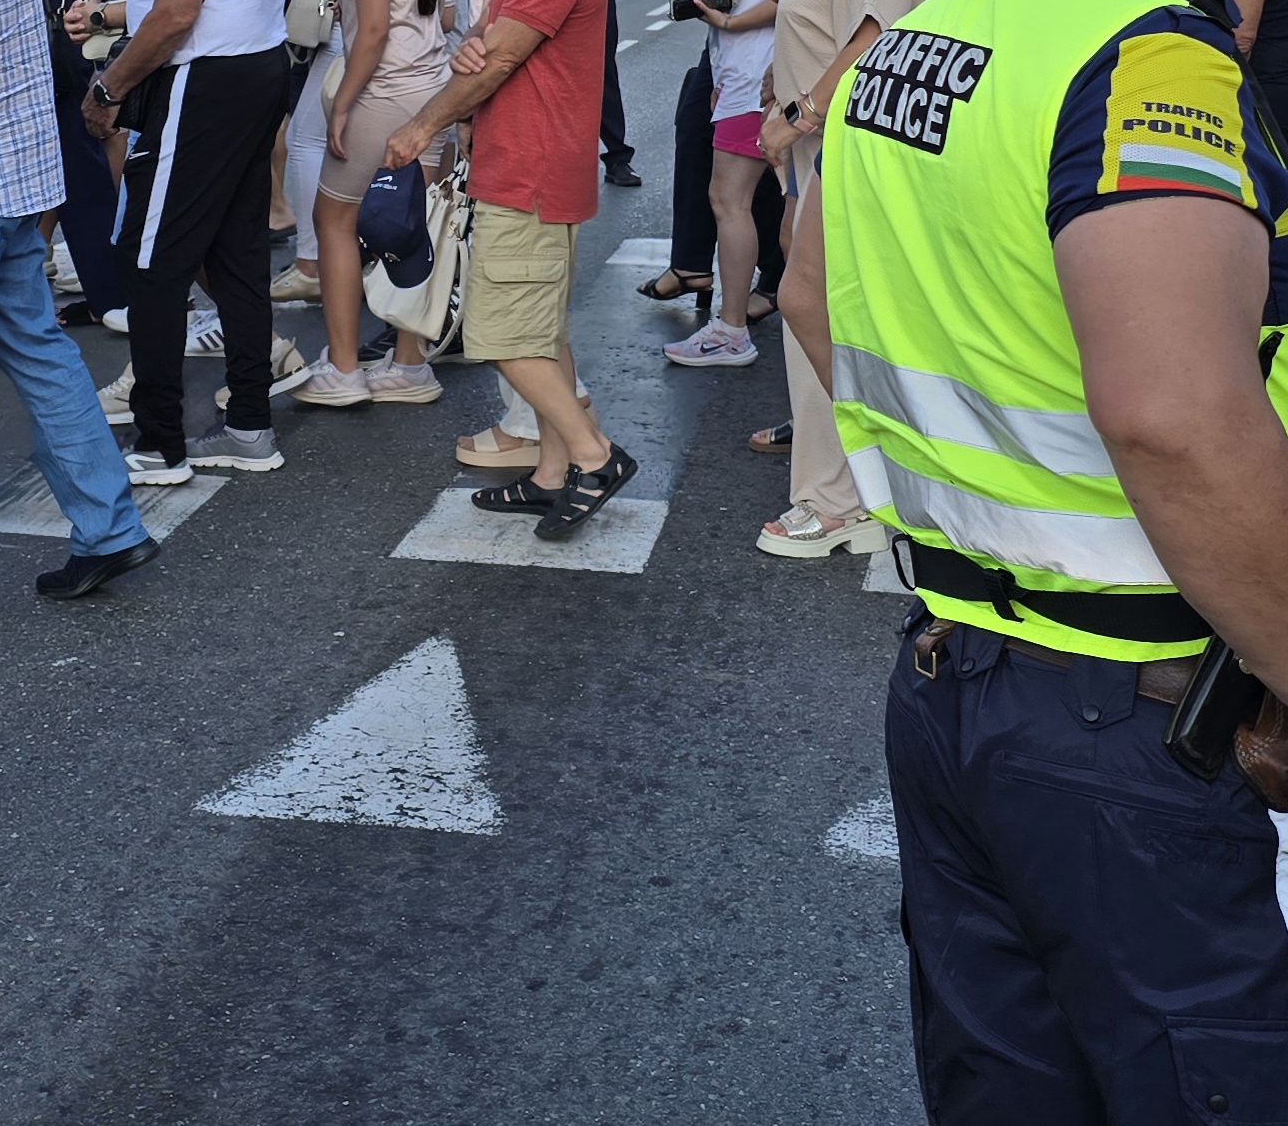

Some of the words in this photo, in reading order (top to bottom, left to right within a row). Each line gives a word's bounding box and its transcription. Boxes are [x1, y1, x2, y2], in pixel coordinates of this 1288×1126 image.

[858, 30, 985, 94] TRAFFIC
[846, 72, 950, 146] POLICE
[1142, 101, 1224, 129] TRAFFIC
[1122, 118, 1237, 158] POLICE
